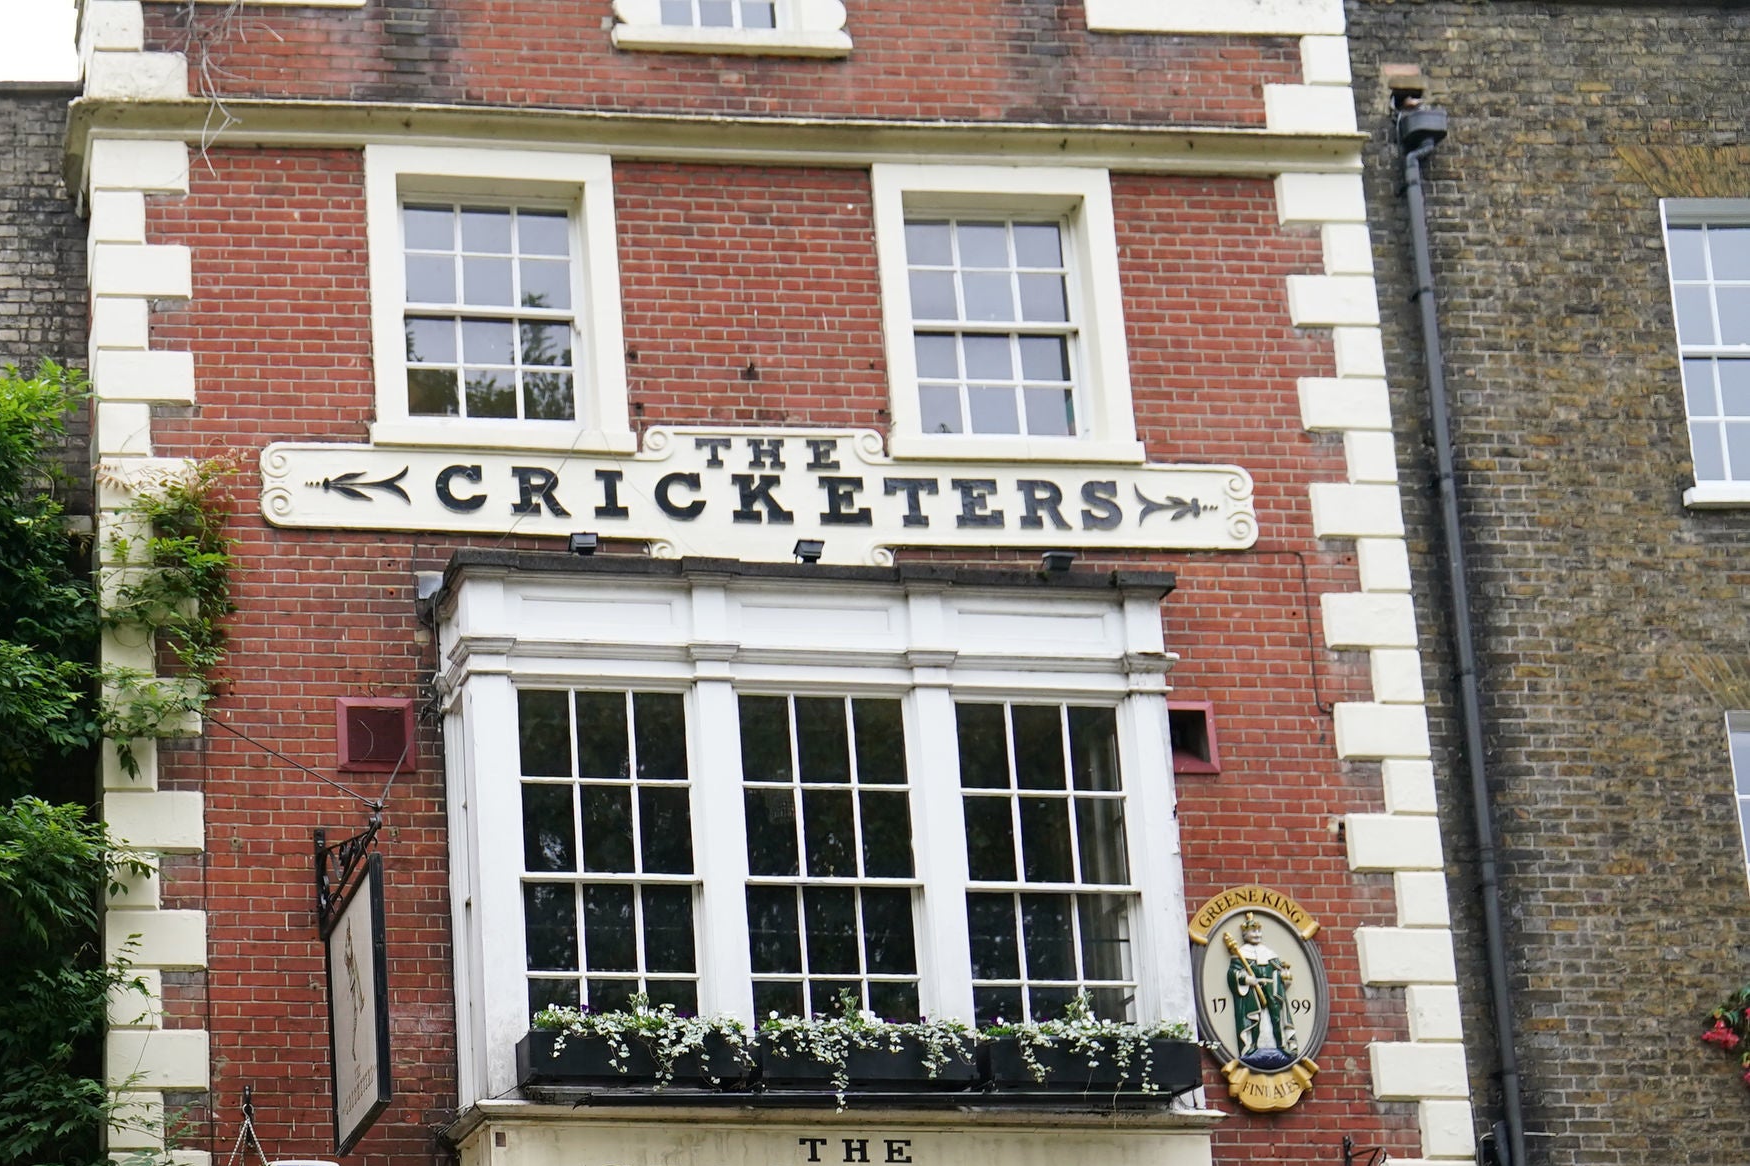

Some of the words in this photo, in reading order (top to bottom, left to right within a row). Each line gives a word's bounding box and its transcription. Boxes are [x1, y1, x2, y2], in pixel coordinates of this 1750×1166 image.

[695, 438, 841, 471] THE
[435, 463, 1123, 532] CRICKETERS
[1198, 889, 1258, 929] GREENE
[1261, 891, 1304, 924] KING
[1212, 998, 1227, 1014] 17
[1291, 999, 1311, 1015] 99
[1242, 1081, 1271, 1097] FINE
[1273, 1078, 1301, 1099] ALES
[799, 1135, 913, 1164] THE
